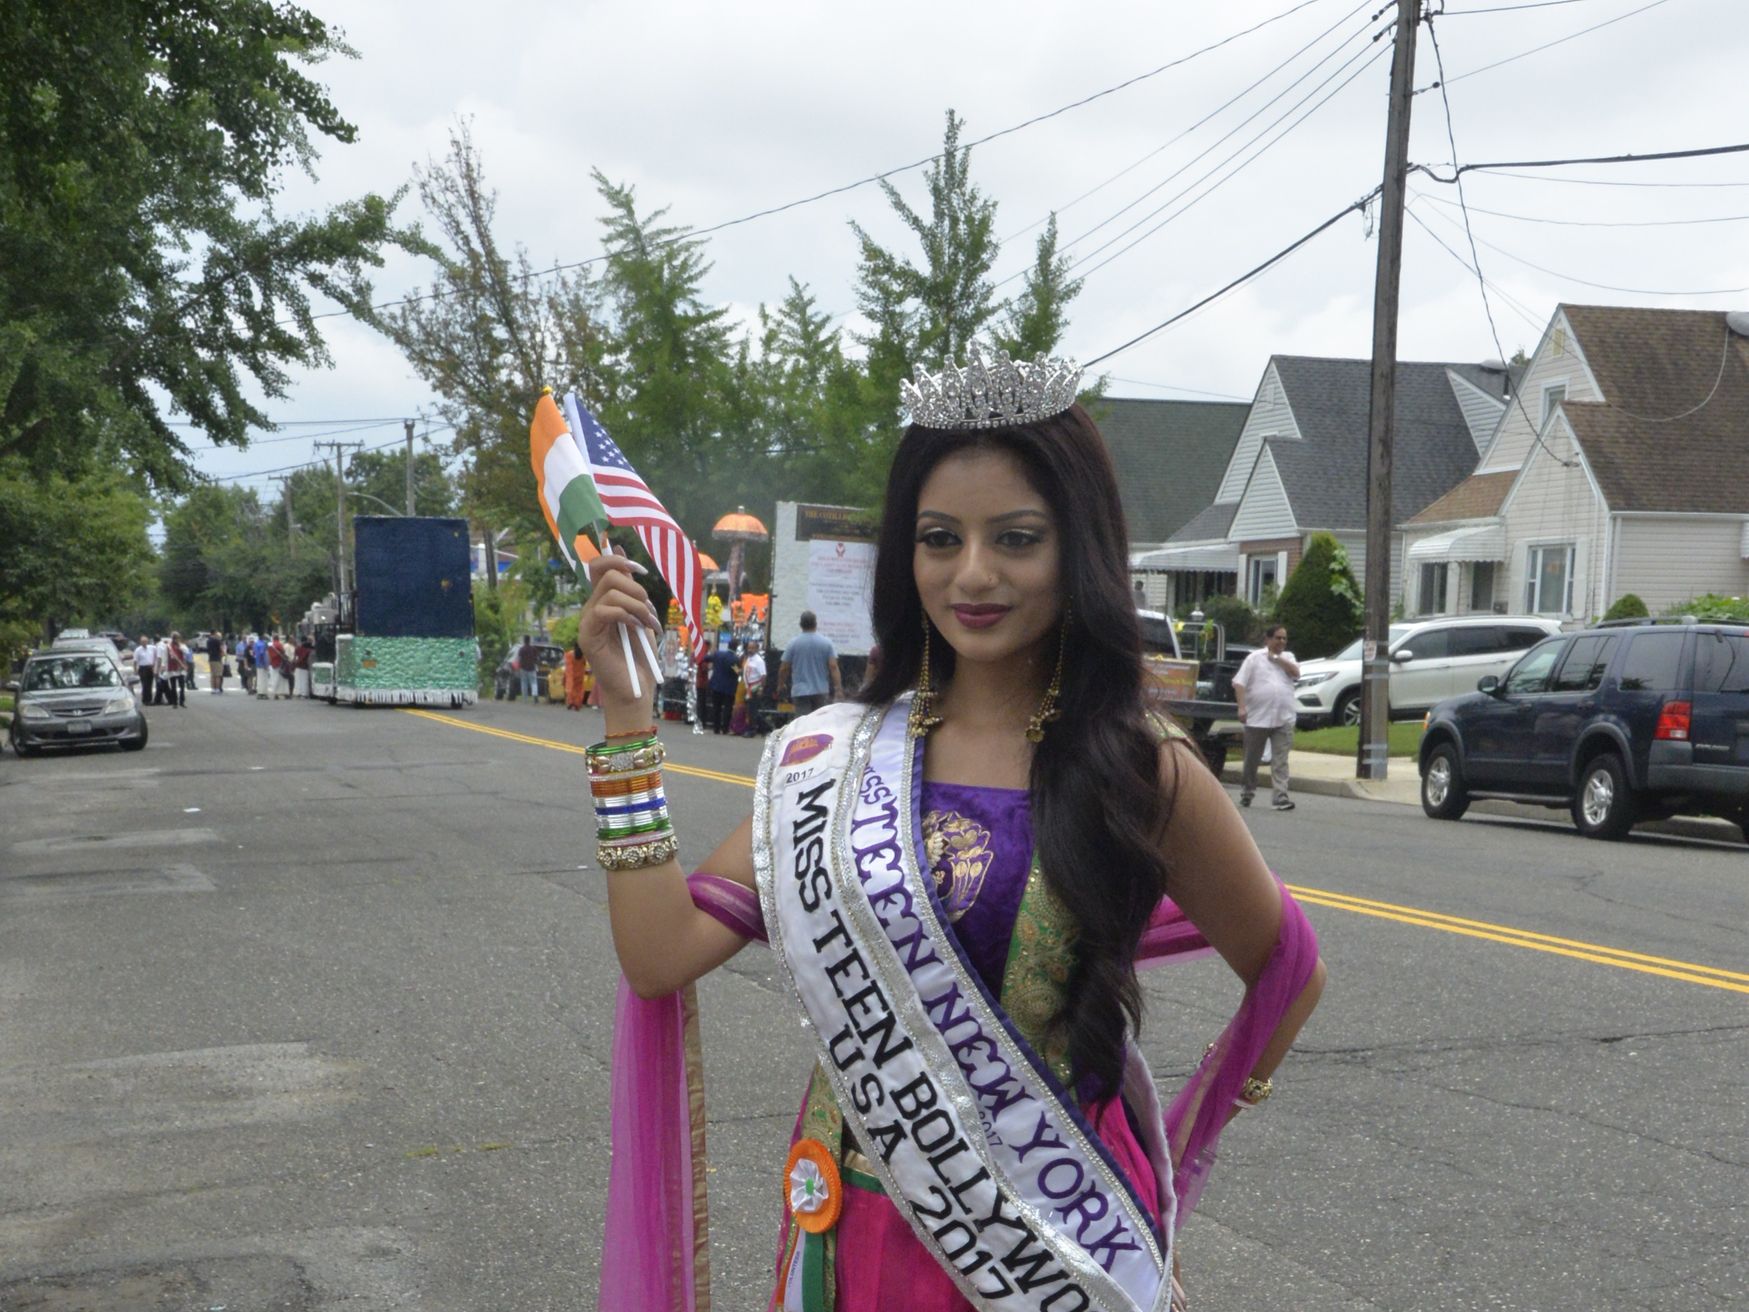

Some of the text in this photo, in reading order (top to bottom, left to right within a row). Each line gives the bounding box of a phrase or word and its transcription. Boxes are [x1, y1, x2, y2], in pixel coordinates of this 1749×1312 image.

[786, 768, 814, 784] 2017
[793, 777, 837, 914] MISS
[813, 911, 914, 1070] TEEN
[851, 796, 943, 981] TEEN
[922, 982, 1034, 1123] NEW
[1009, 1110, 1143, 1275] YORK
[908, 1185, 1014, 1300] 2017
